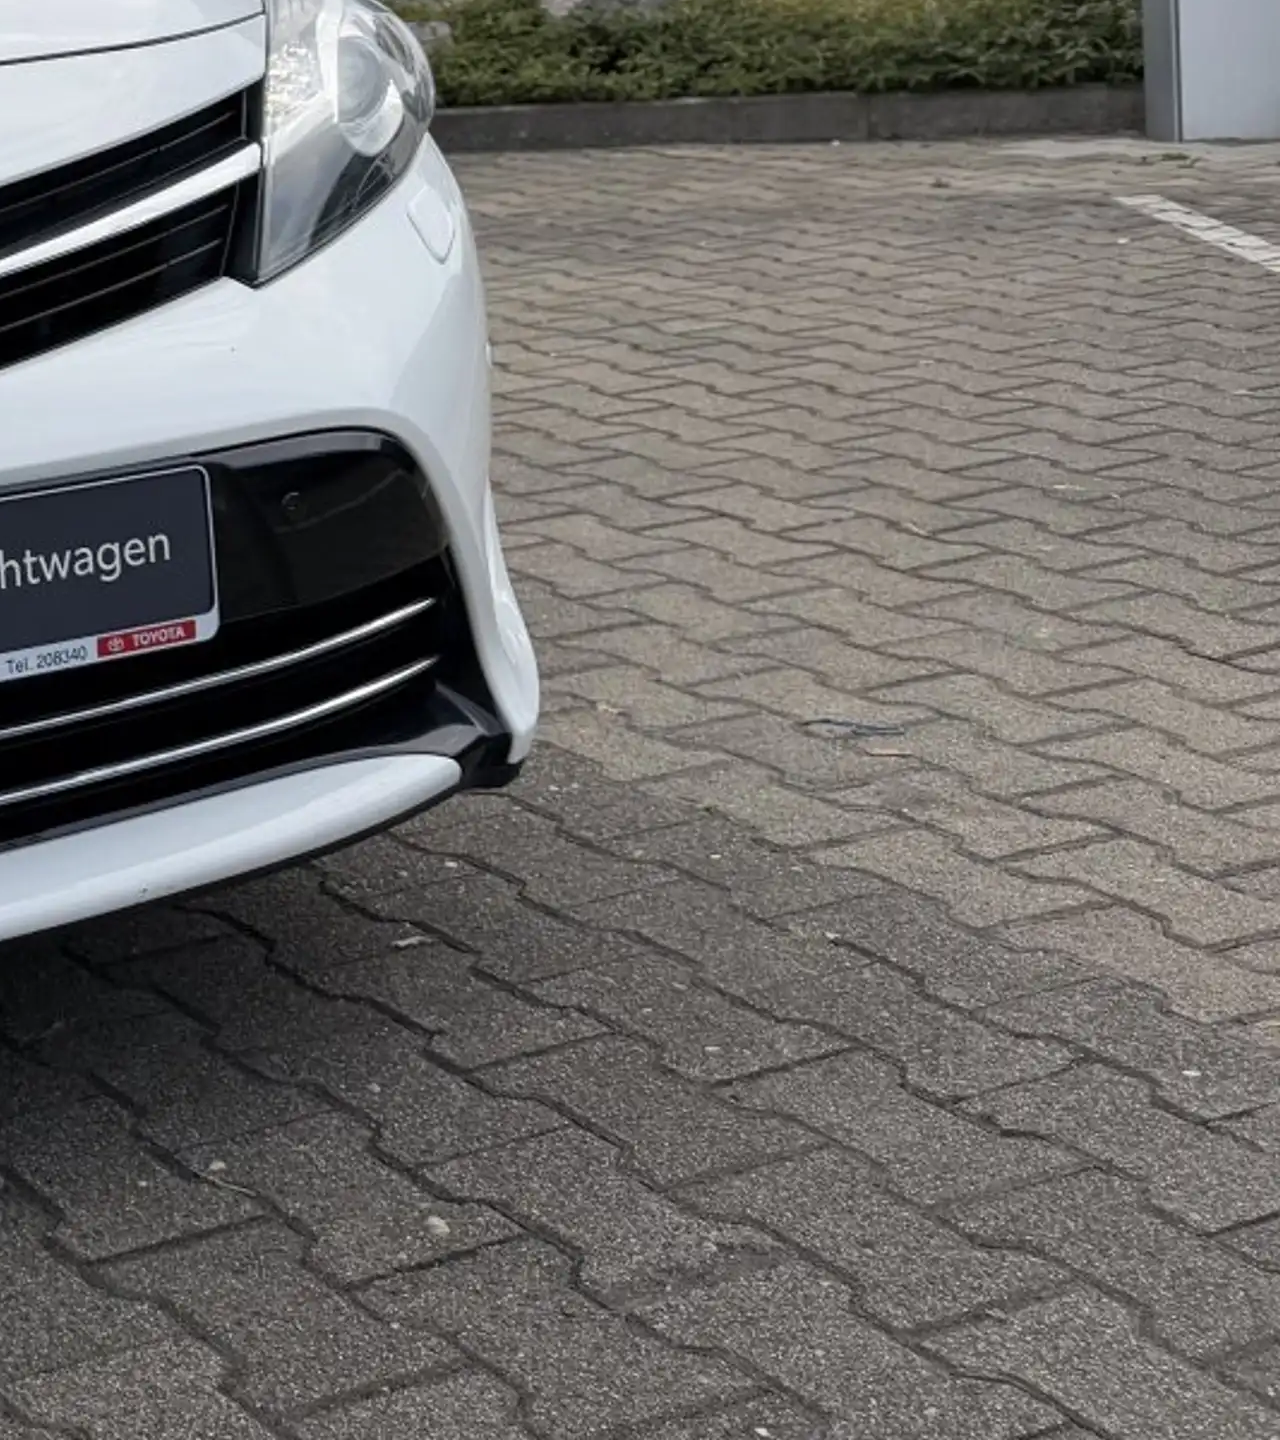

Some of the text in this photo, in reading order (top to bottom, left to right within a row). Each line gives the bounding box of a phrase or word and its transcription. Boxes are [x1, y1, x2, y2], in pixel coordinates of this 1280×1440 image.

[5, 657, 34, 675] Tel.
[36, 645, 89, 670] 208340
[131, 622, 187, 648] TOYOTA
